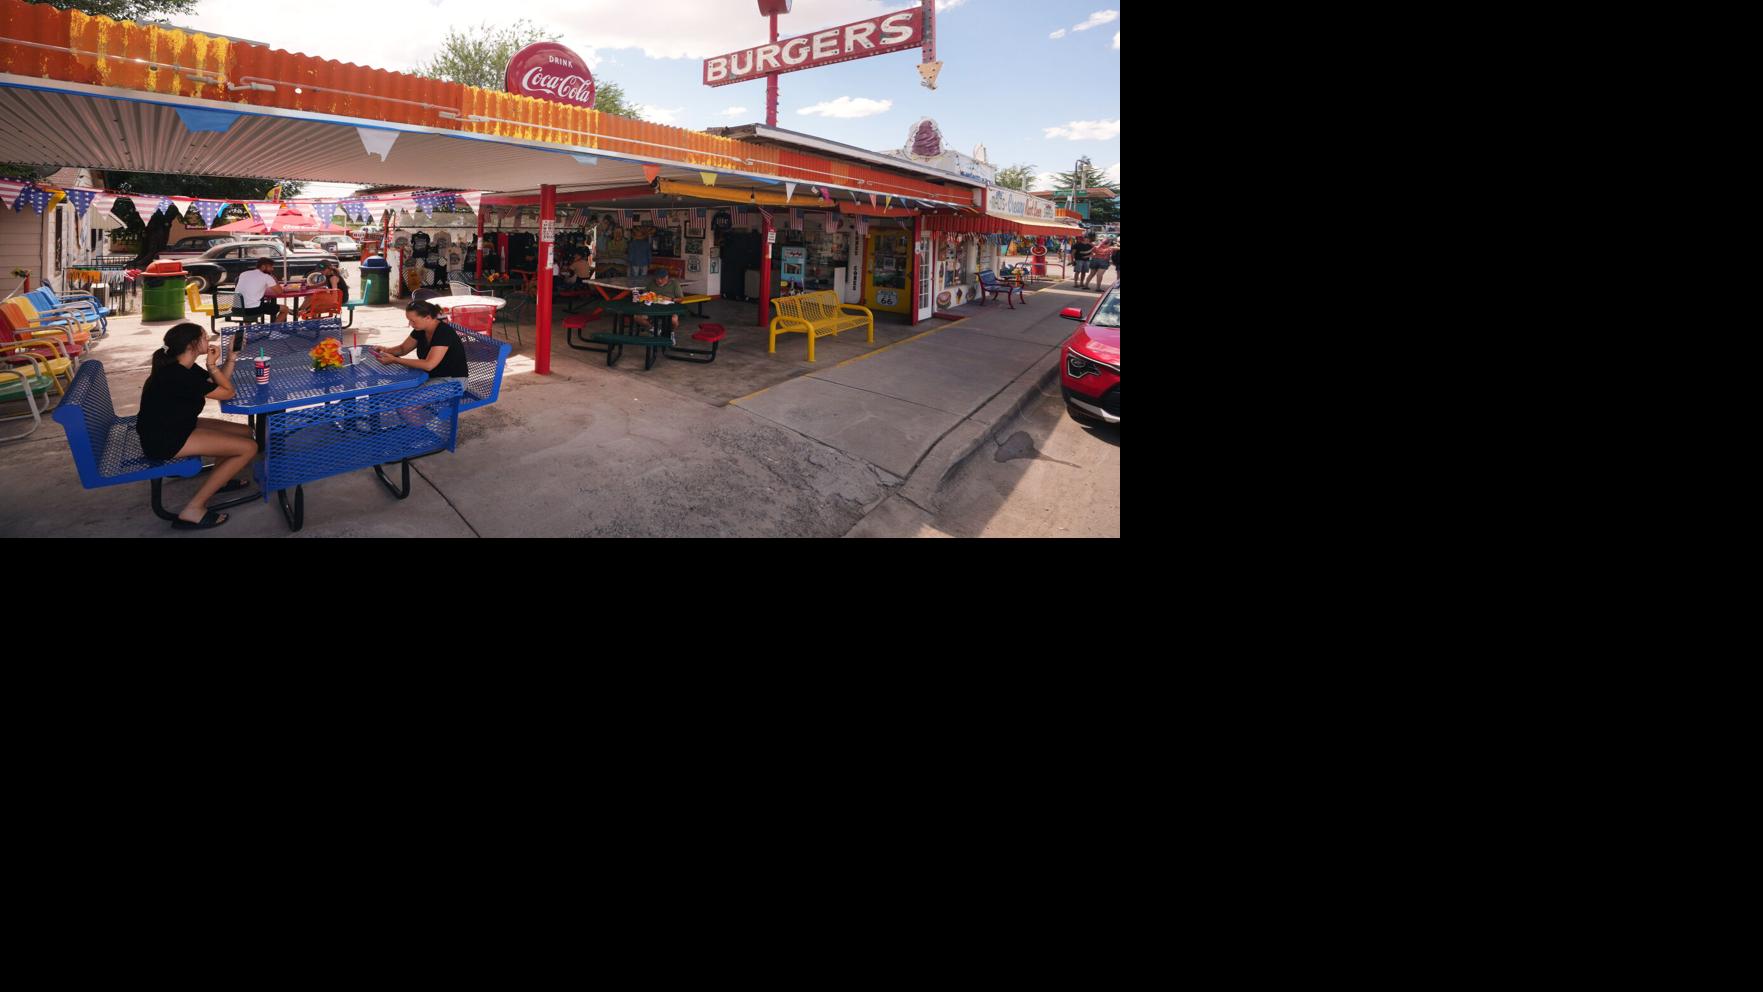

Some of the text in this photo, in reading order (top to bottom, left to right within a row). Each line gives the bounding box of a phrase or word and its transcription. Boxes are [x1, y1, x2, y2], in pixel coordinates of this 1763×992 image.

[707, 13, 913, 82] BURGERS
[548, 55, 574, 68] DRINK
[522, 66, 592, 102] Coca-Cola
[880, 297, 894, 305] 66
